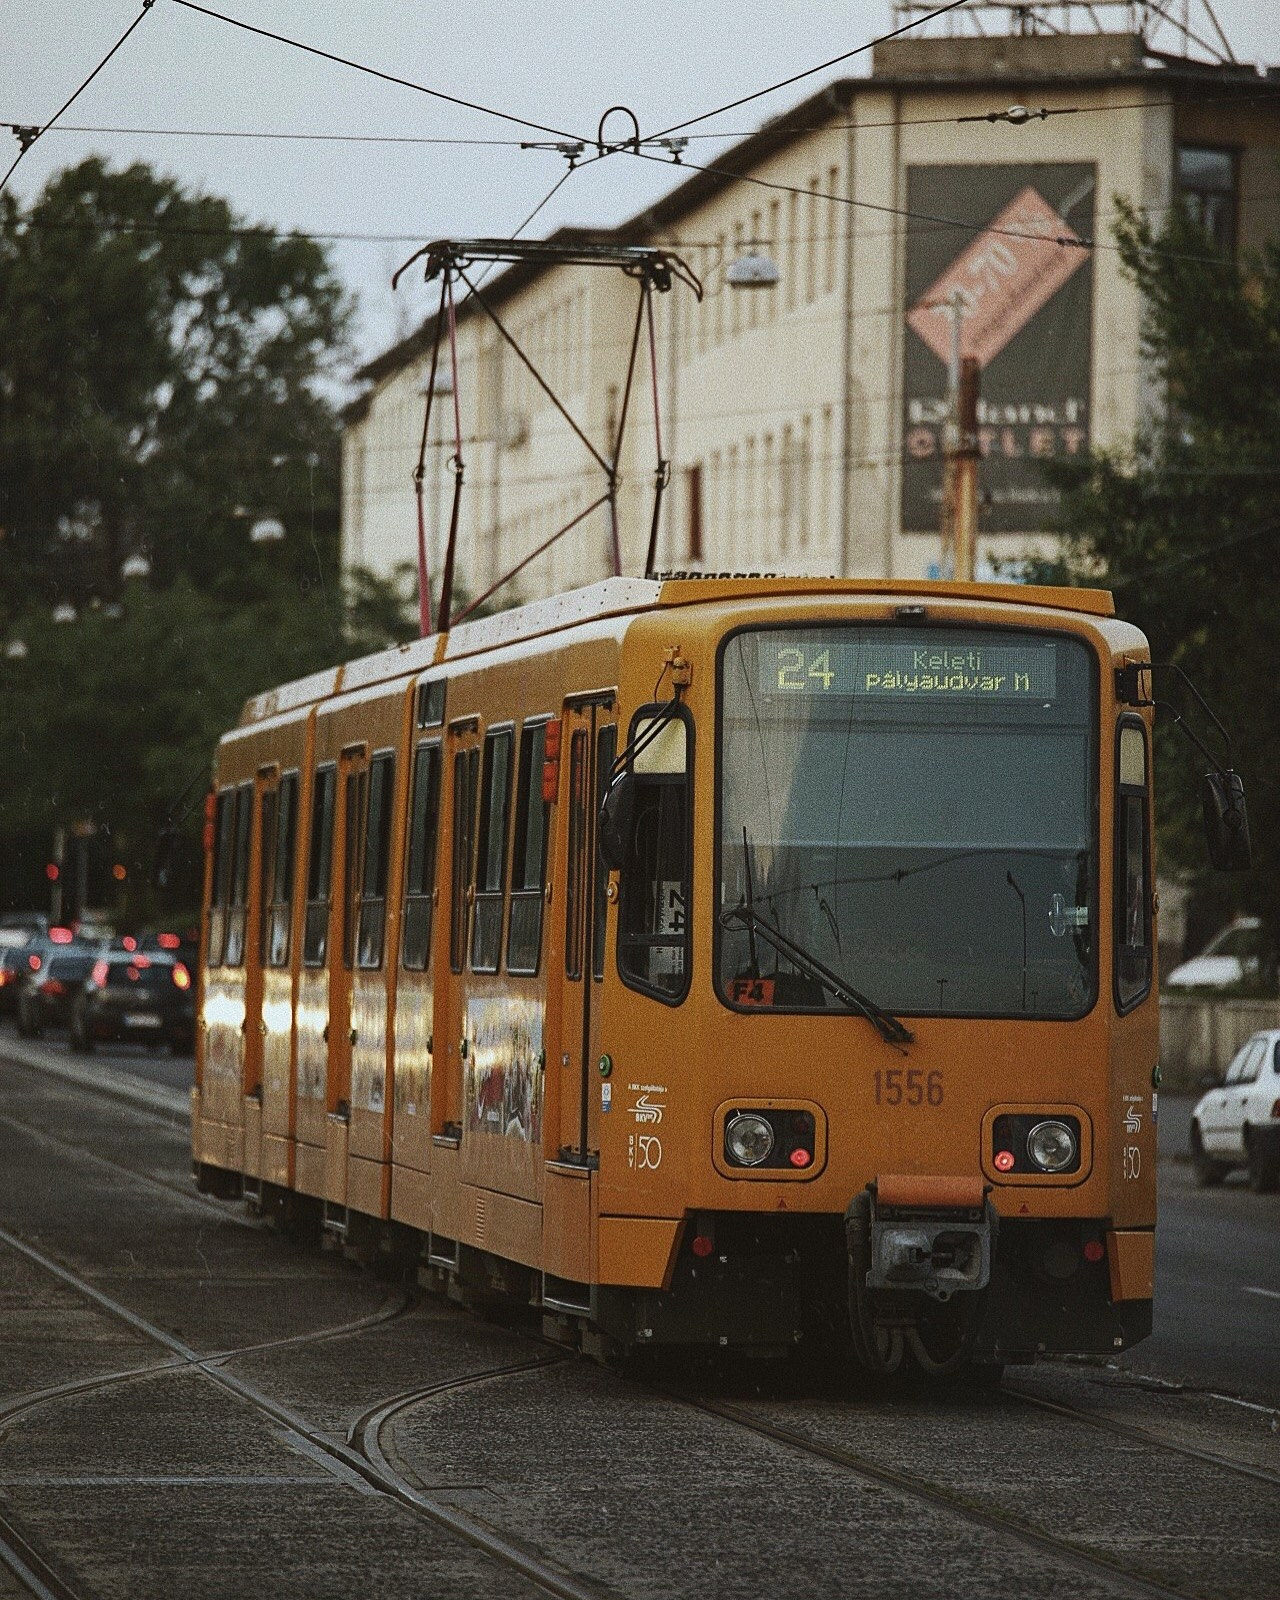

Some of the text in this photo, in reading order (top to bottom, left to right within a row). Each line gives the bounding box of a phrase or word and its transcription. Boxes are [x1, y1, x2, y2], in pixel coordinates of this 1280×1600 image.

[777, 648, 835, 690] 24
[914, 650, 982, 671] Keleti
[1015, 672, 1029, 691] M
[732, 981, 765, 1002] F4
[874, 1069, 944, 1107] 1556
[638, 1135, 662, 1170] 50
